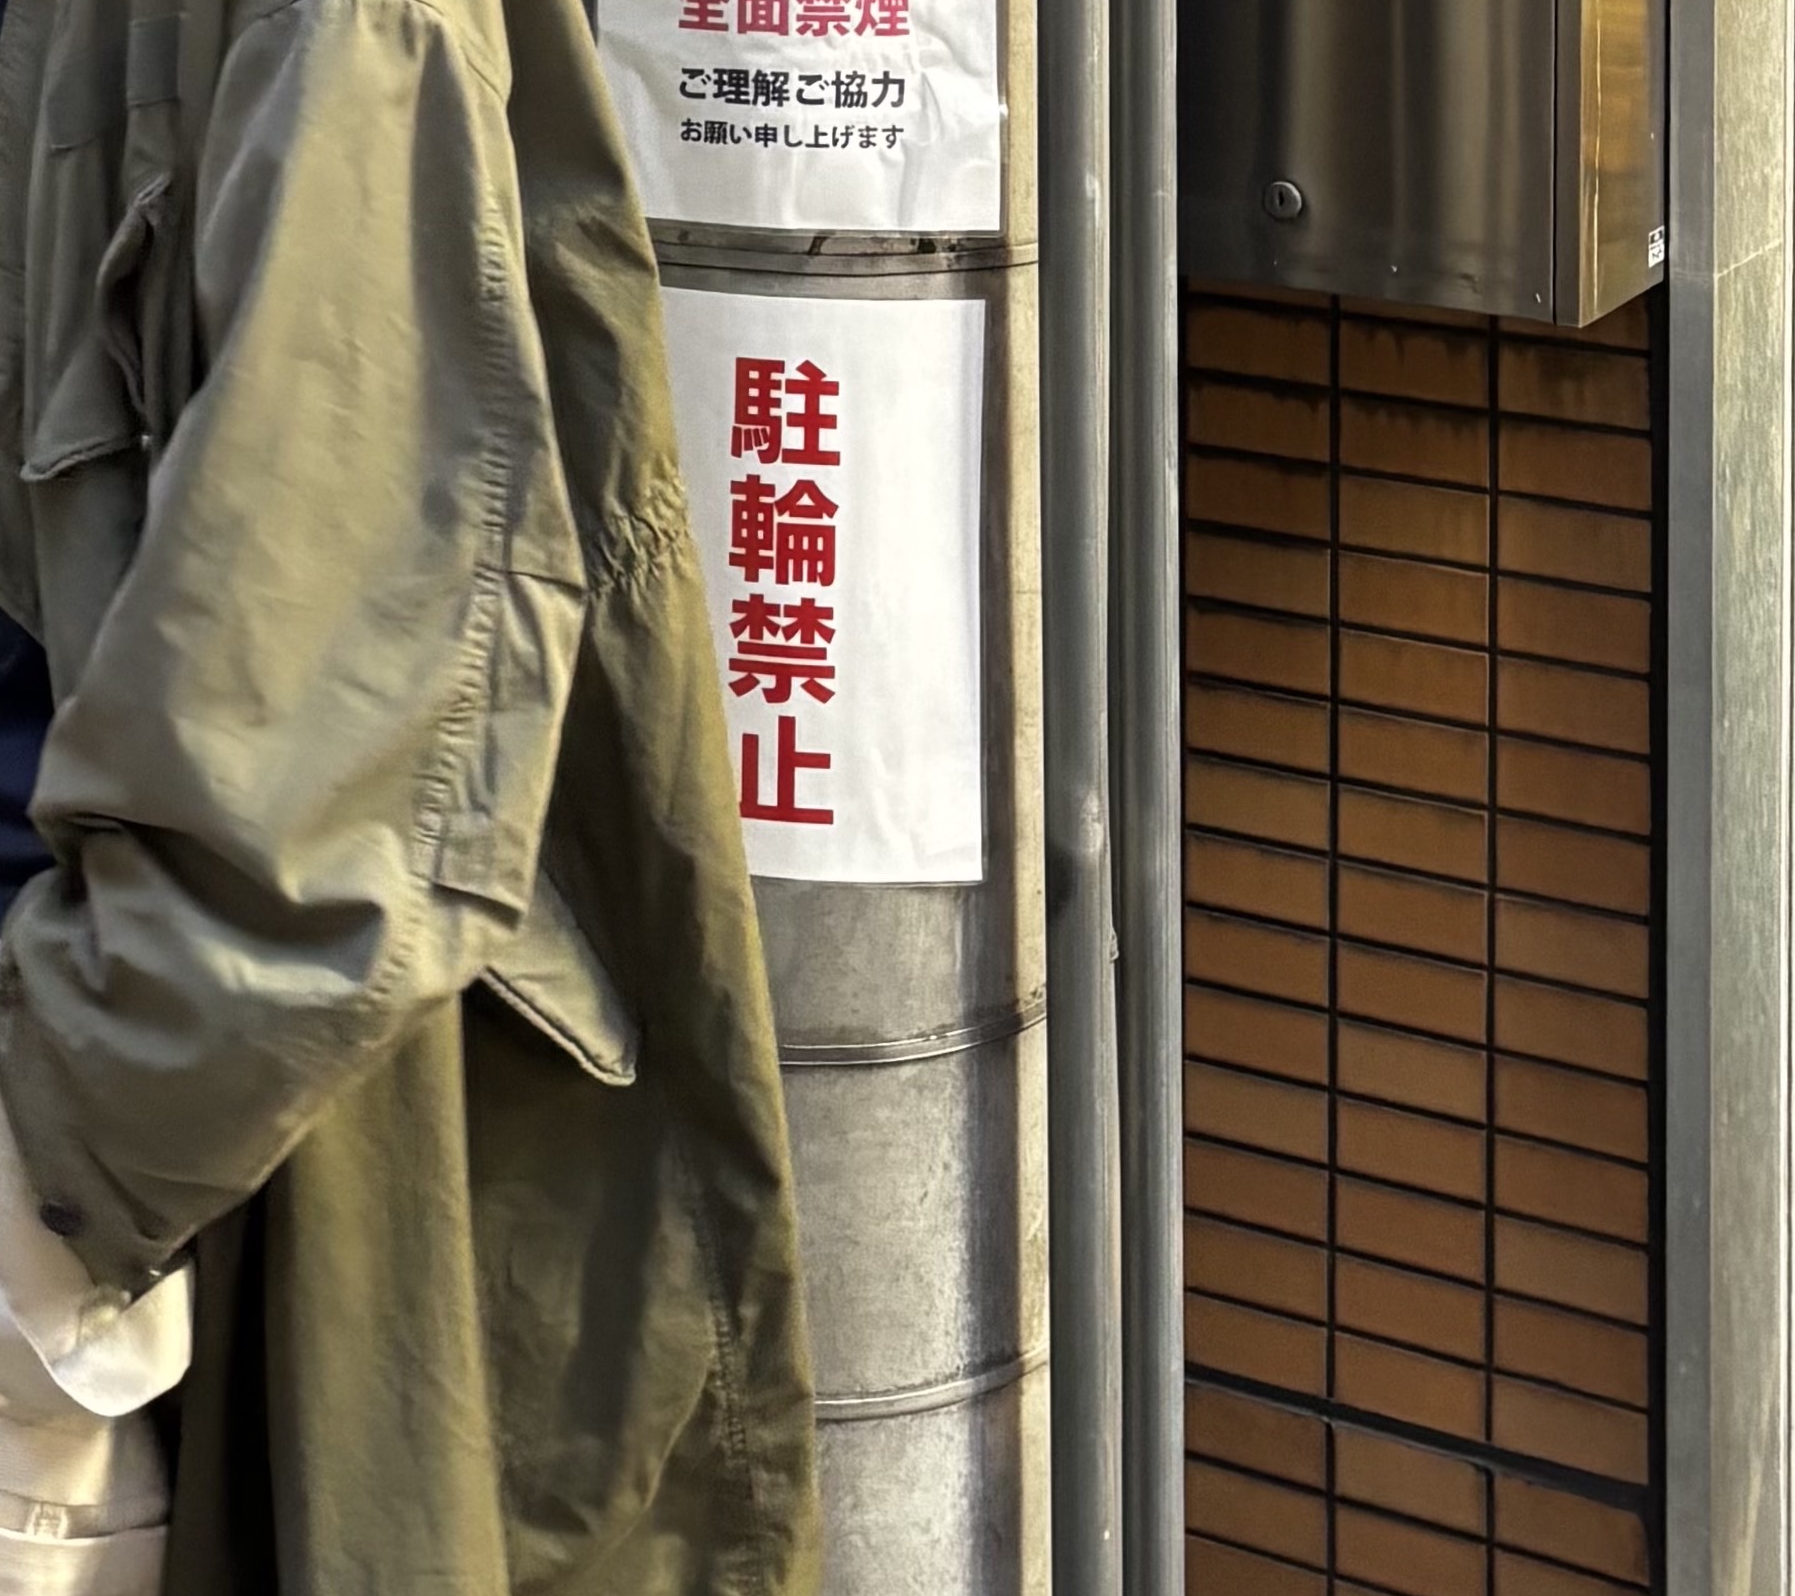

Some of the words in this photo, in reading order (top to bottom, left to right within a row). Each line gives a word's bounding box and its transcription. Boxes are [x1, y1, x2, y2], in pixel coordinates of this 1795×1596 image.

[679, 67, 906, 109] ご理解ご協力
[679, 117, 905, 150] お願い申し上げます
[728, 356, 841, 825] 駐輪禁止
